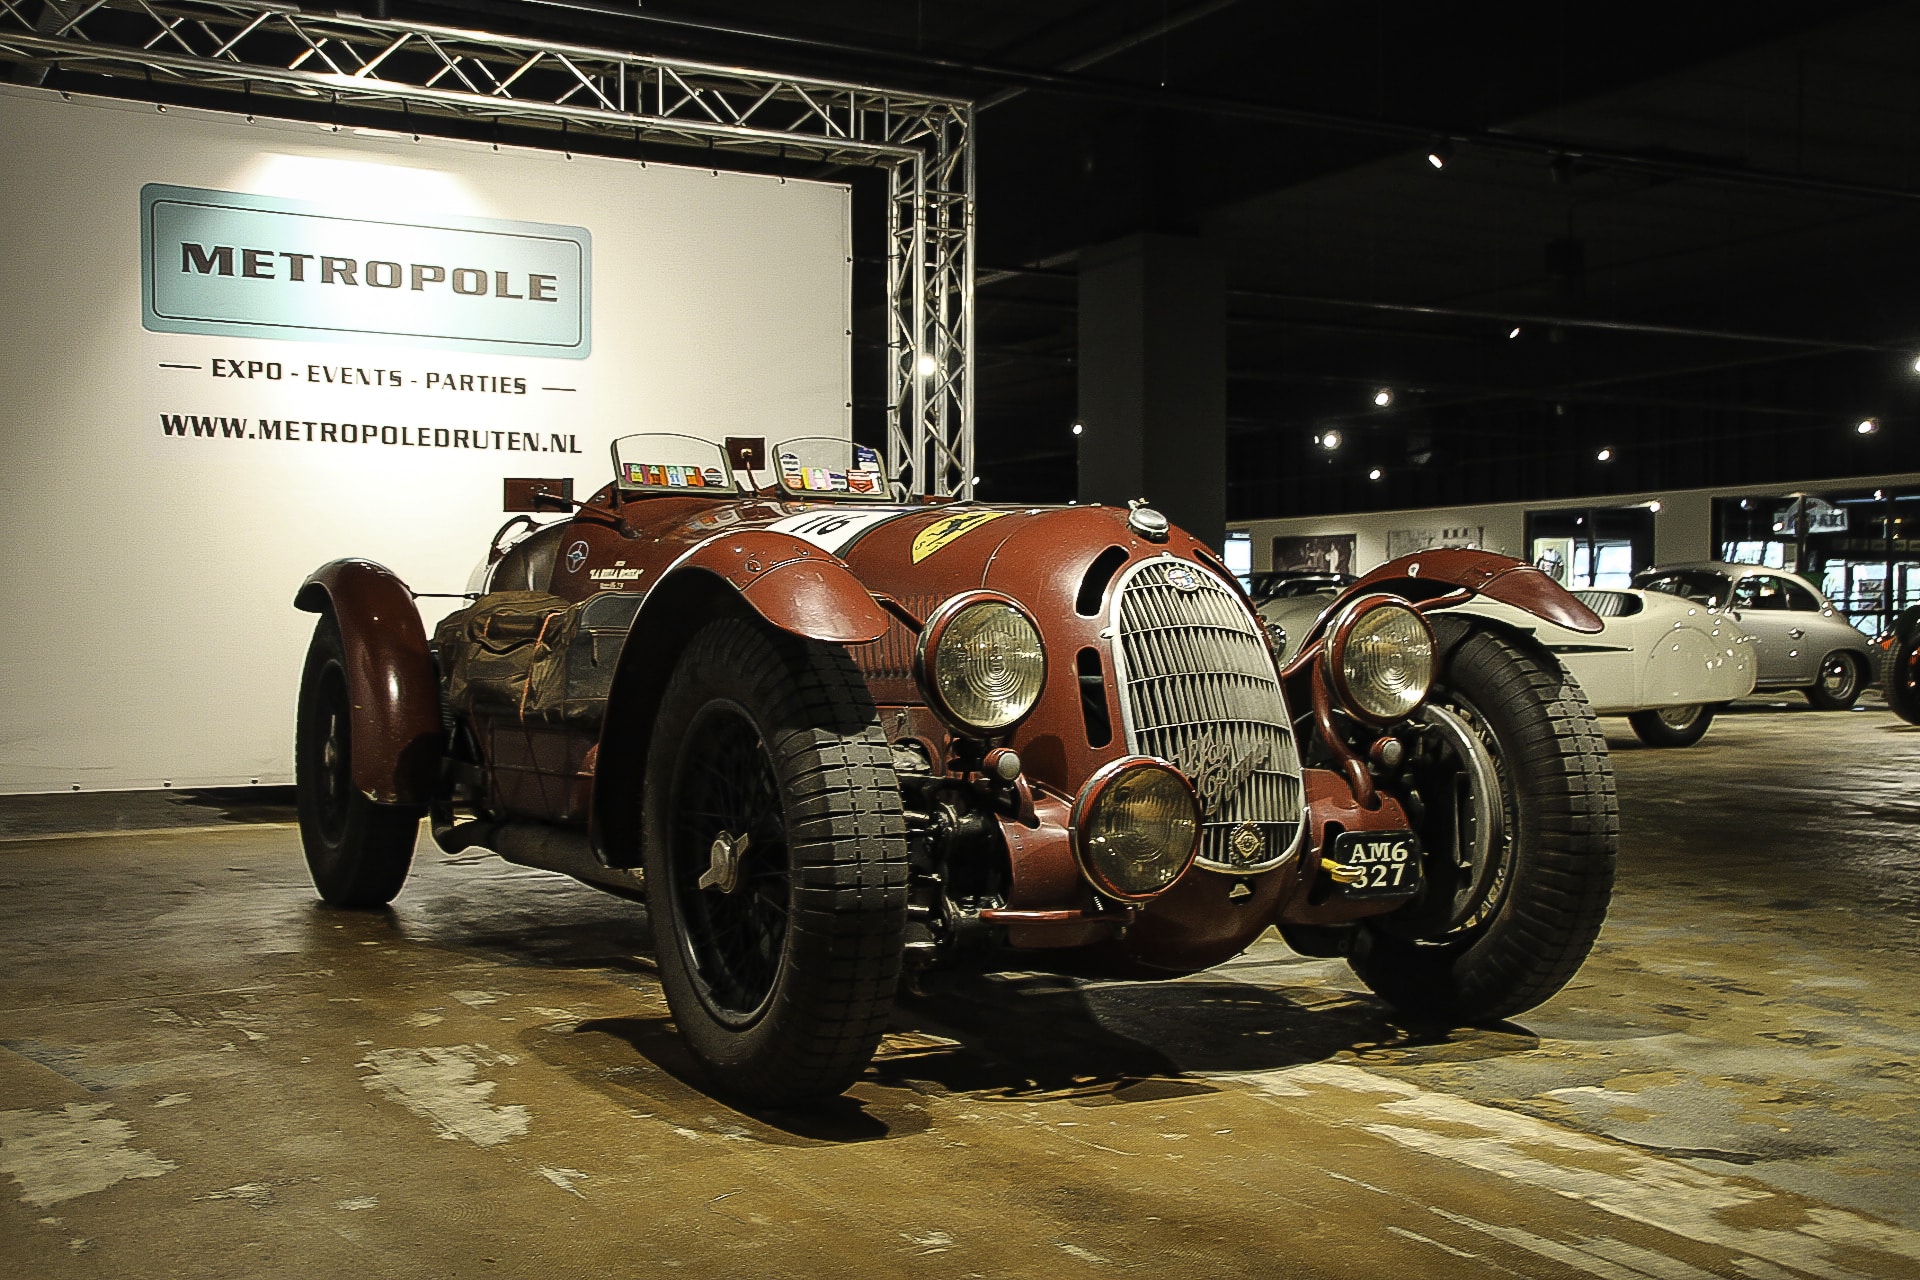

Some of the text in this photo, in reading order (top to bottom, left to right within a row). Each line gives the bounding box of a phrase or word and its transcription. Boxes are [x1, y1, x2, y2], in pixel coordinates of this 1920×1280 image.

[181, 241, 559, 303] METROPOLE
[211, 358, 283, 381] EXPO
[306, 364, 403, 387] EVENTS
[425, 371, 527, 395] PARTIES
[159, 413, 583, 455] WWW.METROPOLEDRUTEN.NL
[1348, 841, 1409, 864] AM6
[1351, 863, 1406, 888] 327
